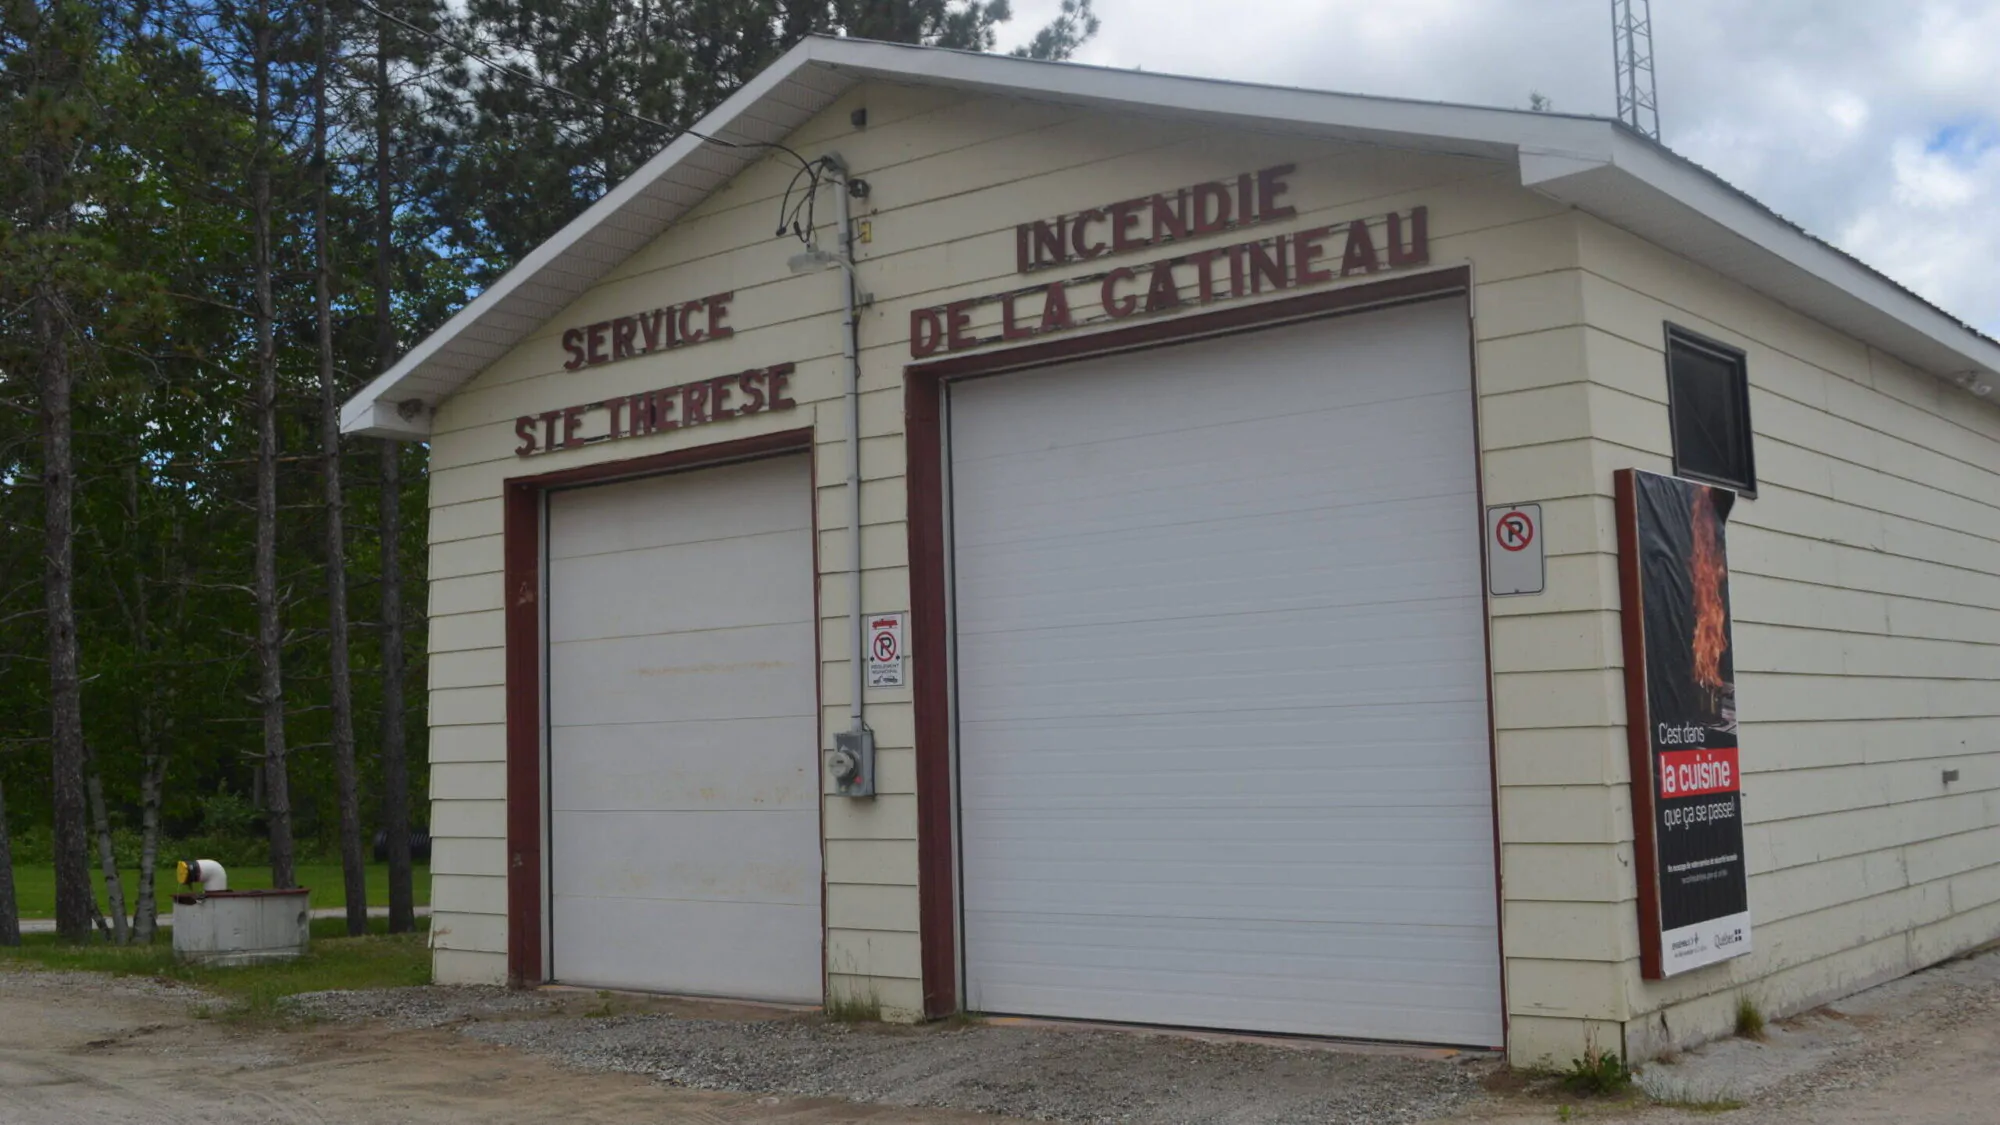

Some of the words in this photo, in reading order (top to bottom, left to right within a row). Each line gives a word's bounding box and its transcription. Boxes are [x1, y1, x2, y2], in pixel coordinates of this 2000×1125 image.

[1016, 163, 1298, 274] INCENDIE
[910, 301, 977, 359] DE
[1001, 281, 1074, 341] LA
[1101, 205, 1429, 318] GATINEAU
[562, 290, 734, 370] SERVICE
[514, 406, 586, 457] STE
[604, 362, 796, 440] THERESE
[1658, 722, 1683, 745] C'est
[1683, 721, 1705, 743] dans
[1661, 755, 1676, 793] la
[1679, 753, 1731, 792] cuisine
[1664, 808, 1682, 832] que
[1683, 806, 1695, 830] ça
[1695, 804, 1707, 822] se
